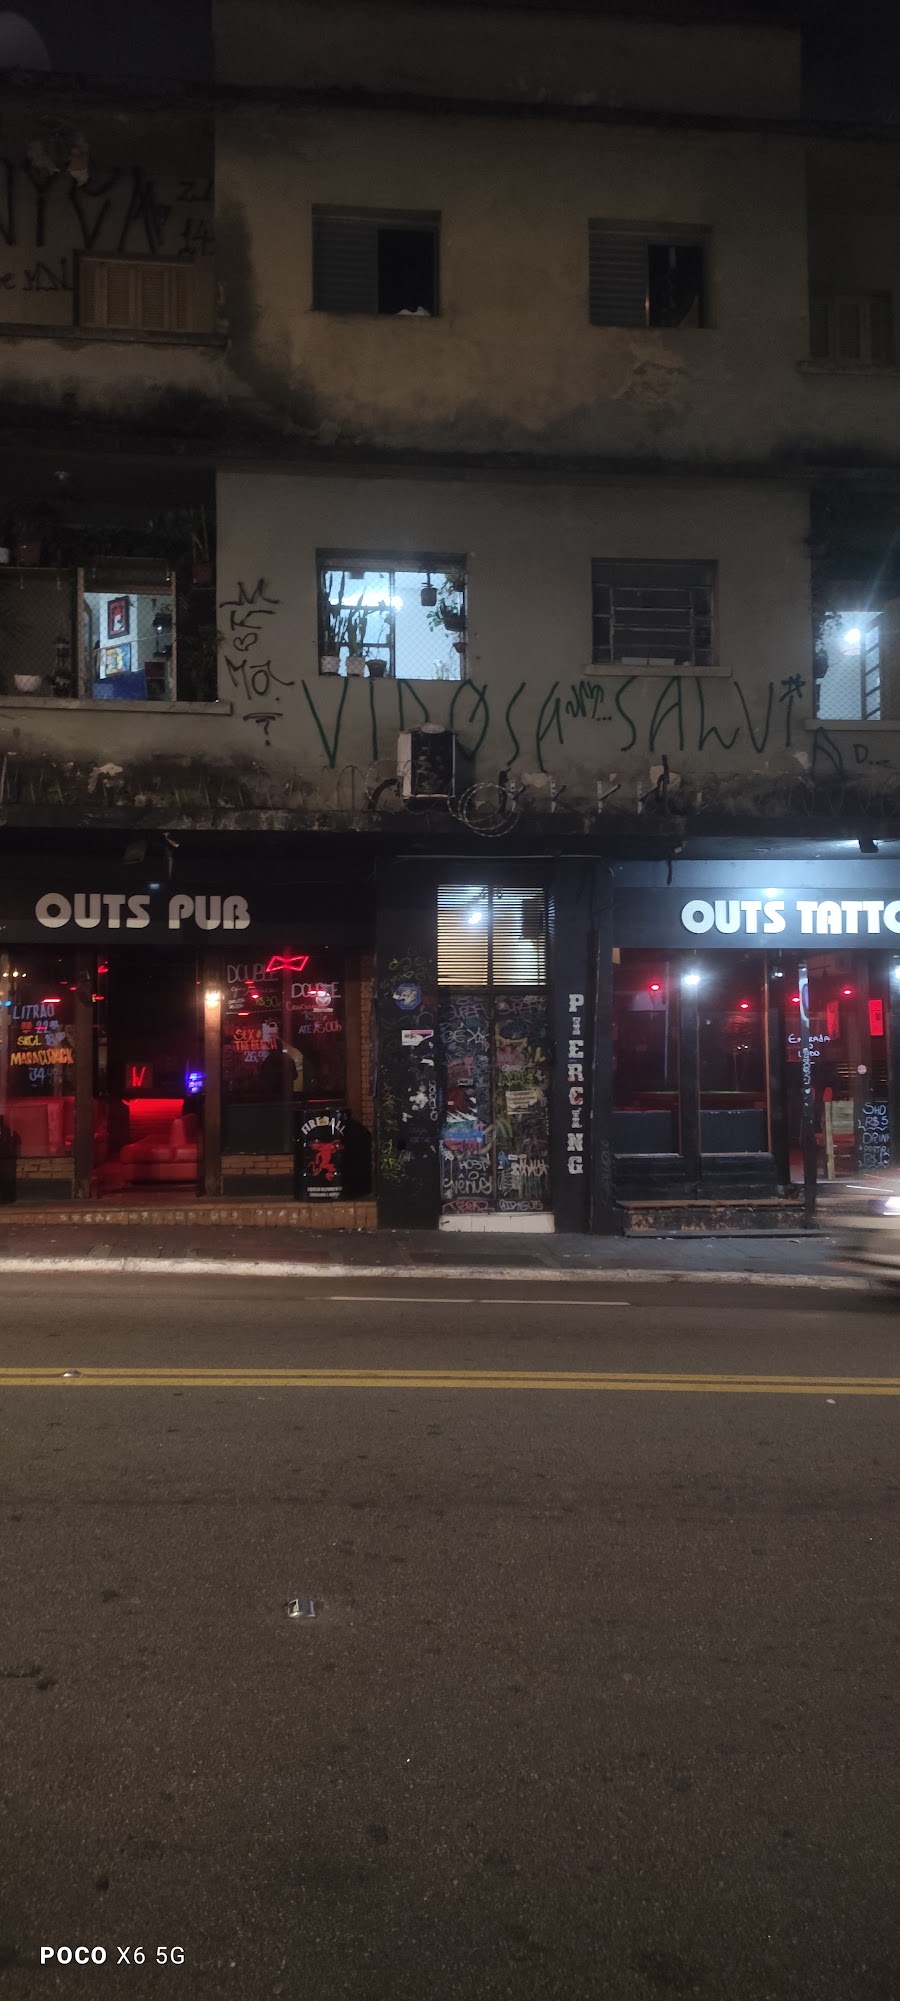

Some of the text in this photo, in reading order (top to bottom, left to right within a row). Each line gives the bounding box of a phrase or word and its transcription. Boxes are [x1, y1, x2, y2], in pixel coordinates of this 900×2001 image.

[35, 892, 251, 930] OUTS PUB
[681, 899, 787, 935] OUTS
[291, 981, 341, 998] DOUBE
[568, 993, 584, 1175] PIERCING
[301, 1116, 346, 1137] FIREBALL
